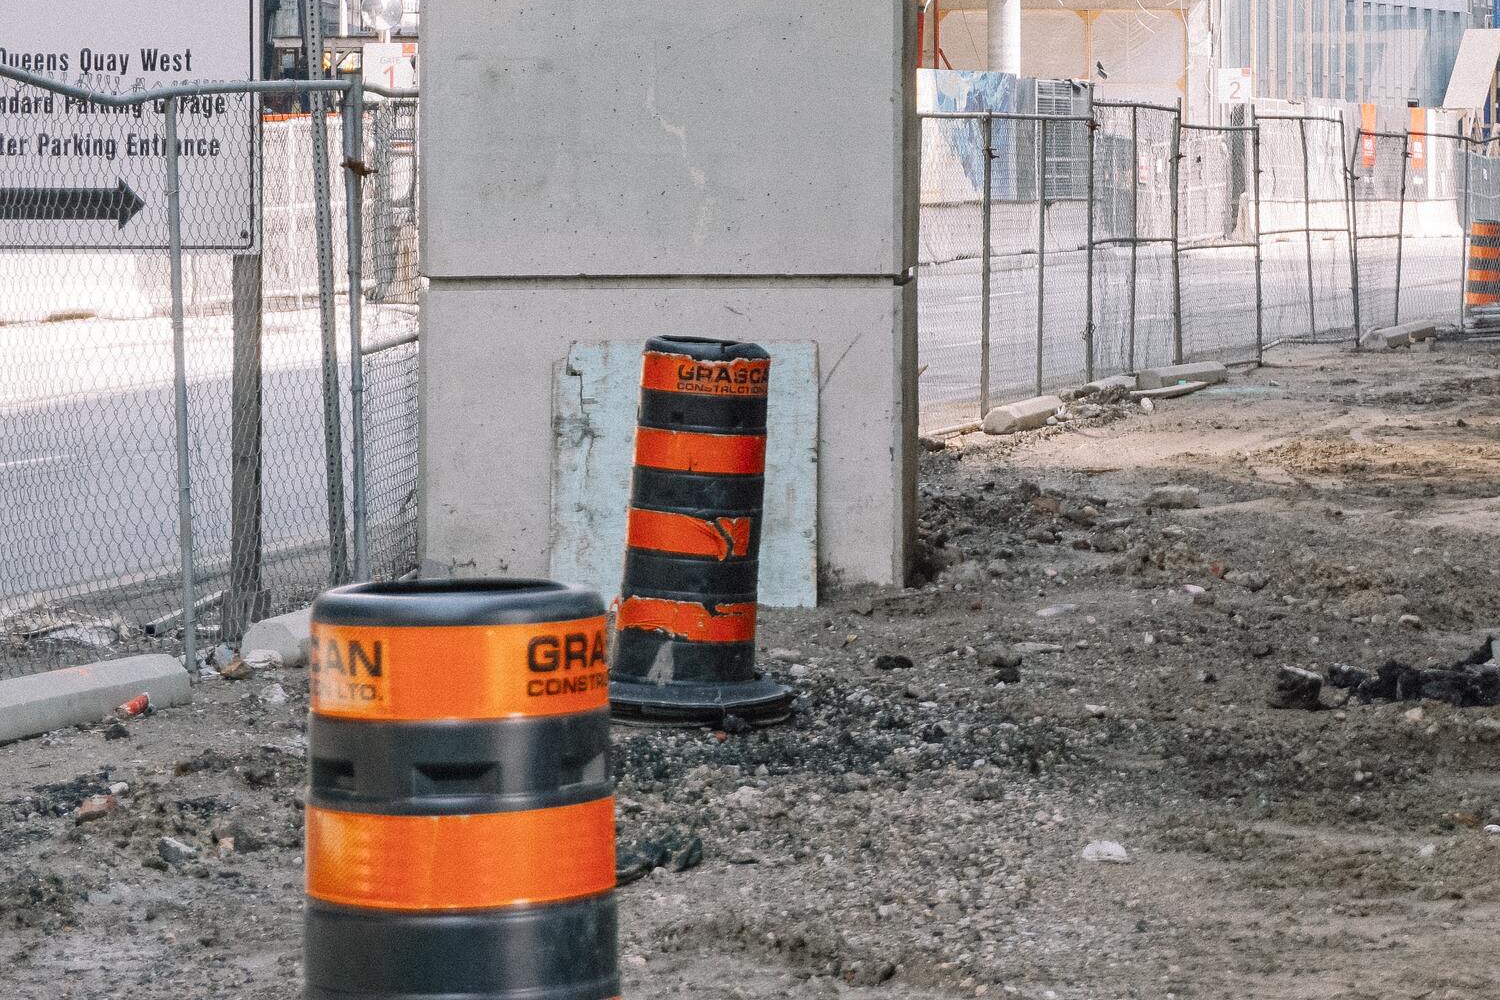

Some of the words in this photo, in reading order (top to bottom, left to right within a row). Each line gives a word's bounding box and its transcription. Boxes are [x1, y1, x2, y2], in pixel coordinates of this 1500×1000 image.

[80, 47, 130, 75] Quay
[141, 48, 192, 72] West
[383, 66, 394, 88] 1
[1229, 81, 1241, 99] 2
[153, 92, 226, 119] Grage
[38, 132, 116, 160] Parking
